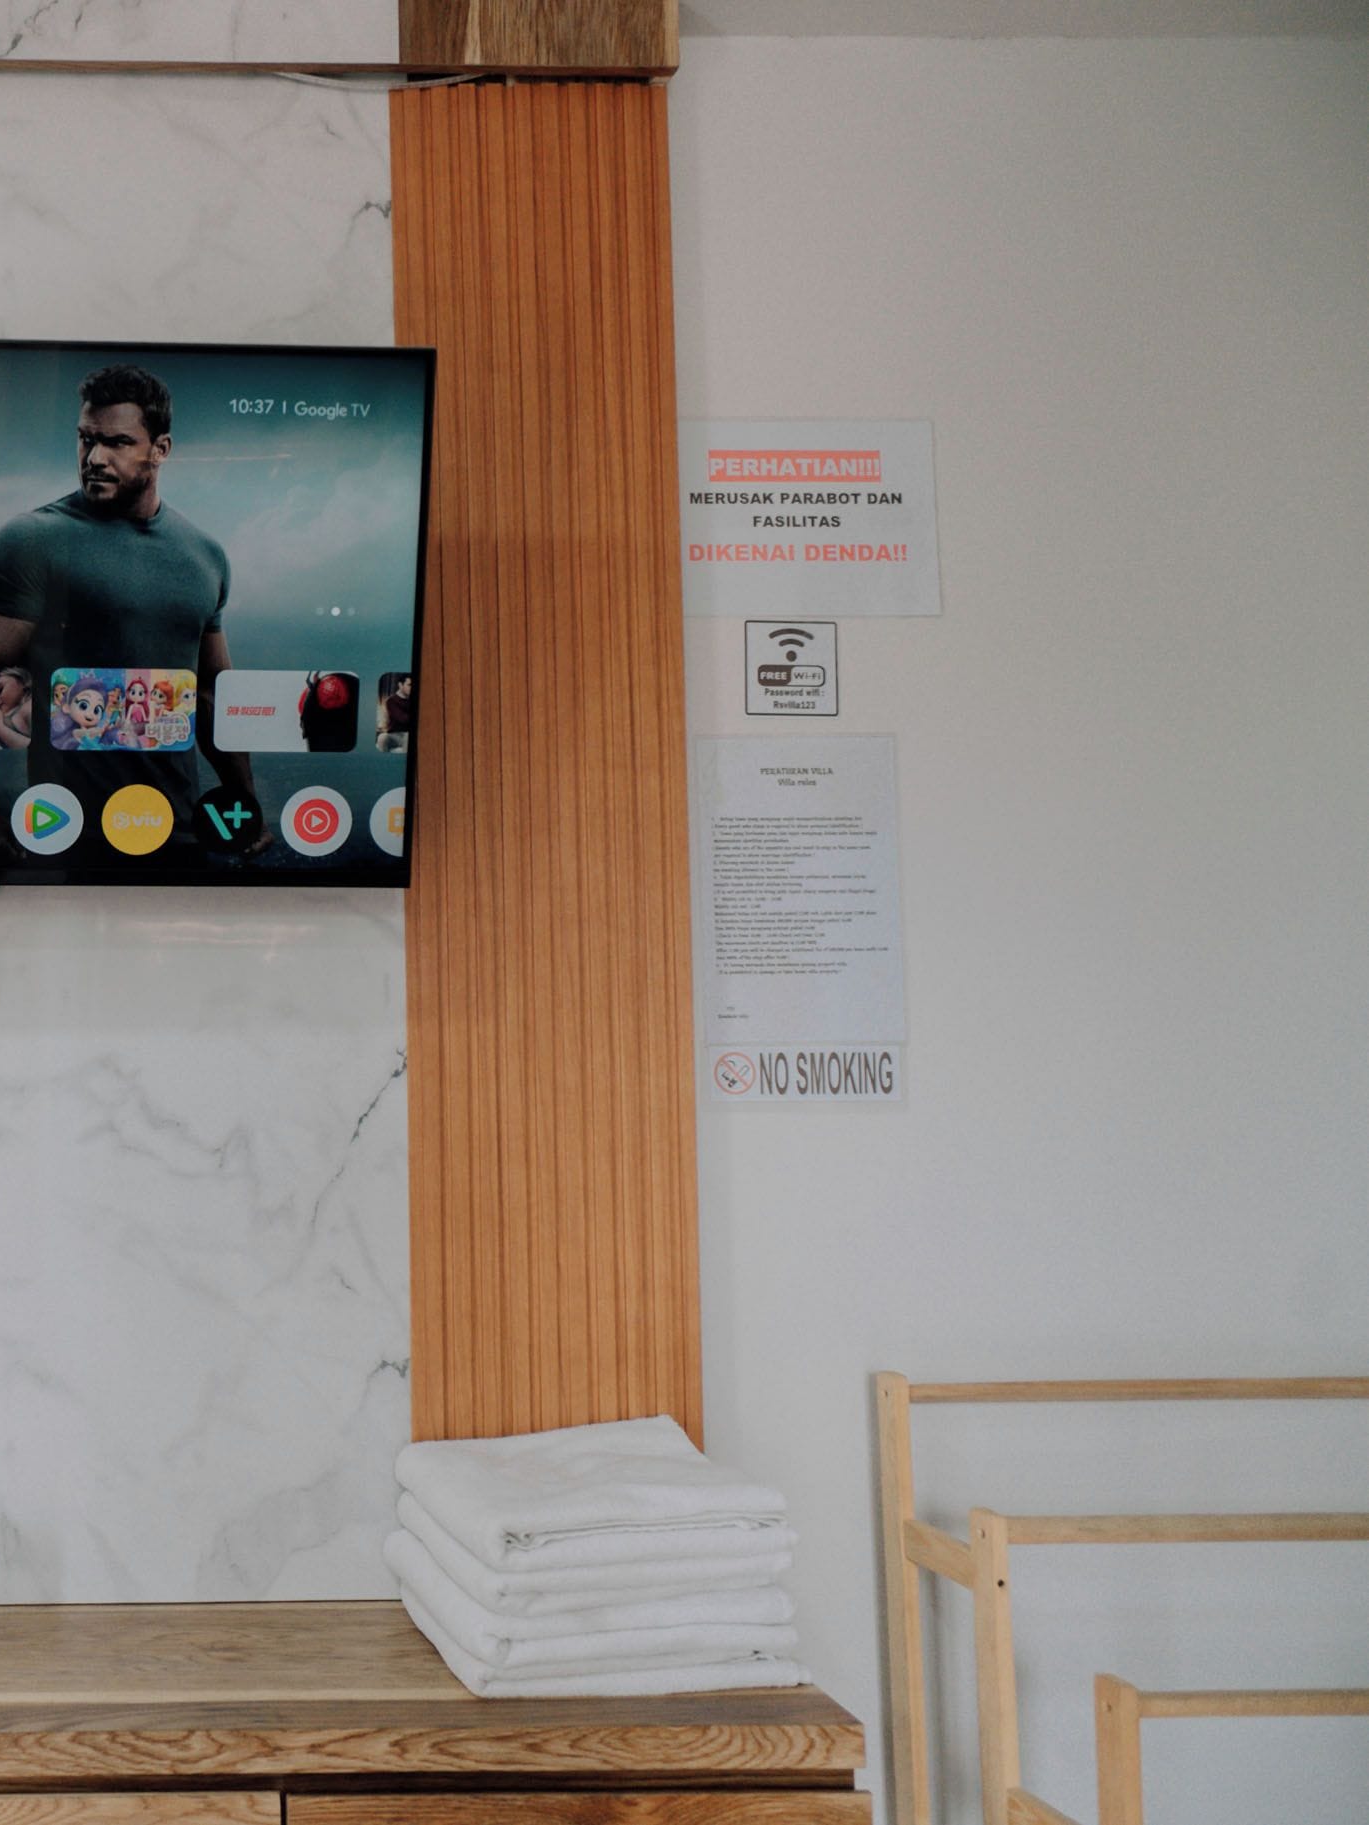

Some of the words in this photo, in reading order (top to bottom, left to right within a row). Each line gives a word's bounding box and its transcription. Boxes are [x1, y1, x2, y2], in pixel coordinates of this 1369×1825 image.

[229, 398, 274, 415] 10:37
[294, 401, 348, 421] Google
[352, 402, 371, 418] TV
[710, 457, 880, 477] PERHATIAN!!!
[689, 492, 774, 505] MERUSAK
[780, 492, 862, 505] PARABOT
[867, 493, 903, 505] DAN
[752, 515, 842, 528] FASILITAS
[688, 543, 795, 562] DIKENAI
[804, 544, 908, 562] DENDA!!
[759, 671, 788, 681] FREE
[764, 688, 804, 697] Password
[133, 811, 163, 827] viu
[759, 1051, 789, 1096] NO
[796, 1051, 894, 1096] SMOKING
